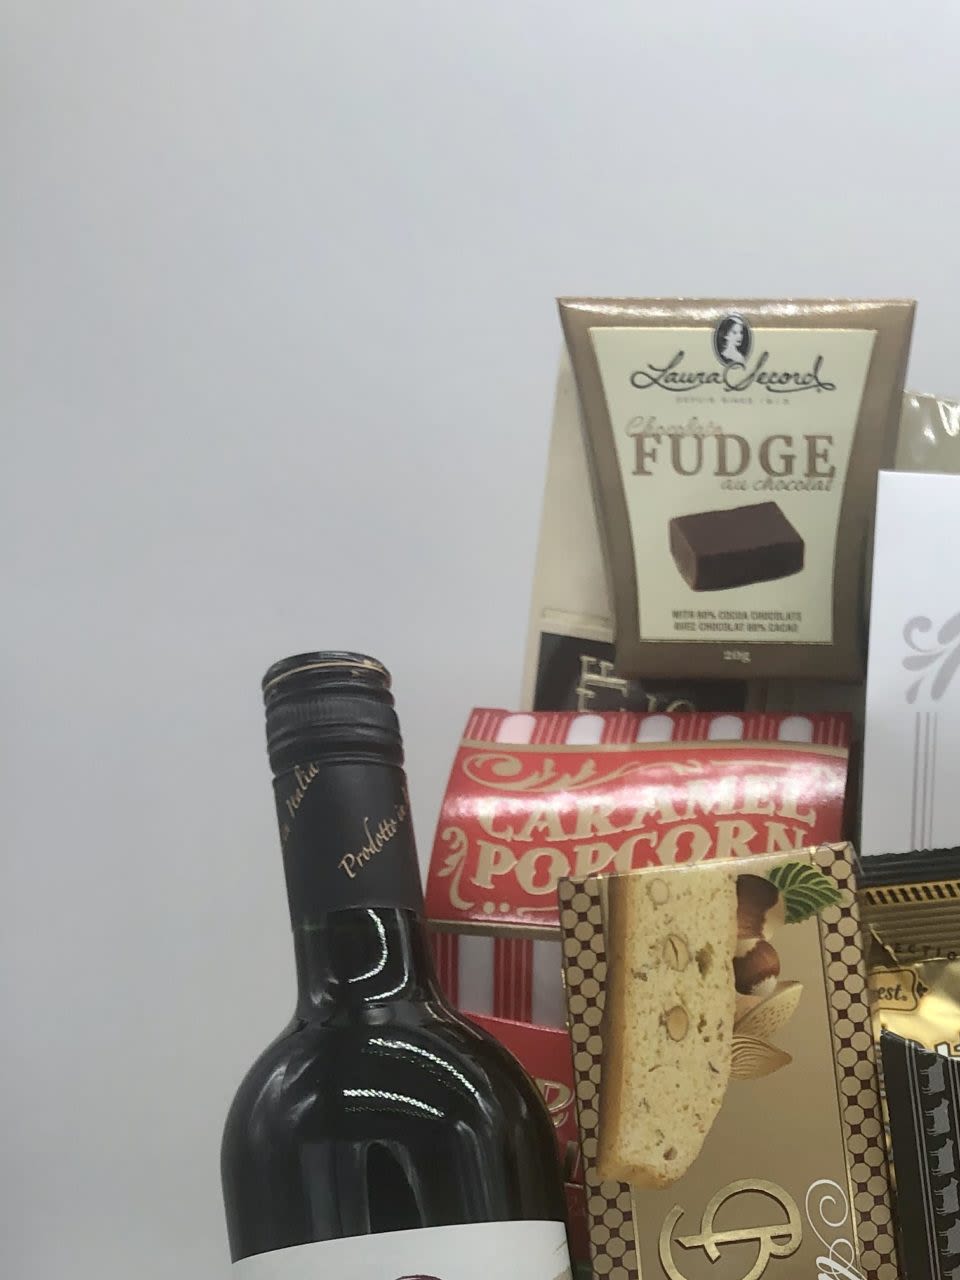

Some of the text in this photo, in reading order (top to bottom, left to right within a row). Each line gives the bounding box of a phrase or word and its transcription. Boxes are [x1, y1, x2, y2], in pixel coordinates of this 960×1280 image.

[629, 350, 837, 393] Laura Secord
[631, 433, 837, 479] FUDGE
[475, 776, 817, 843] CARAMEL
[337, 816, 398, 879] Prodotto
[470, 819, 809, 896] POPCORN
